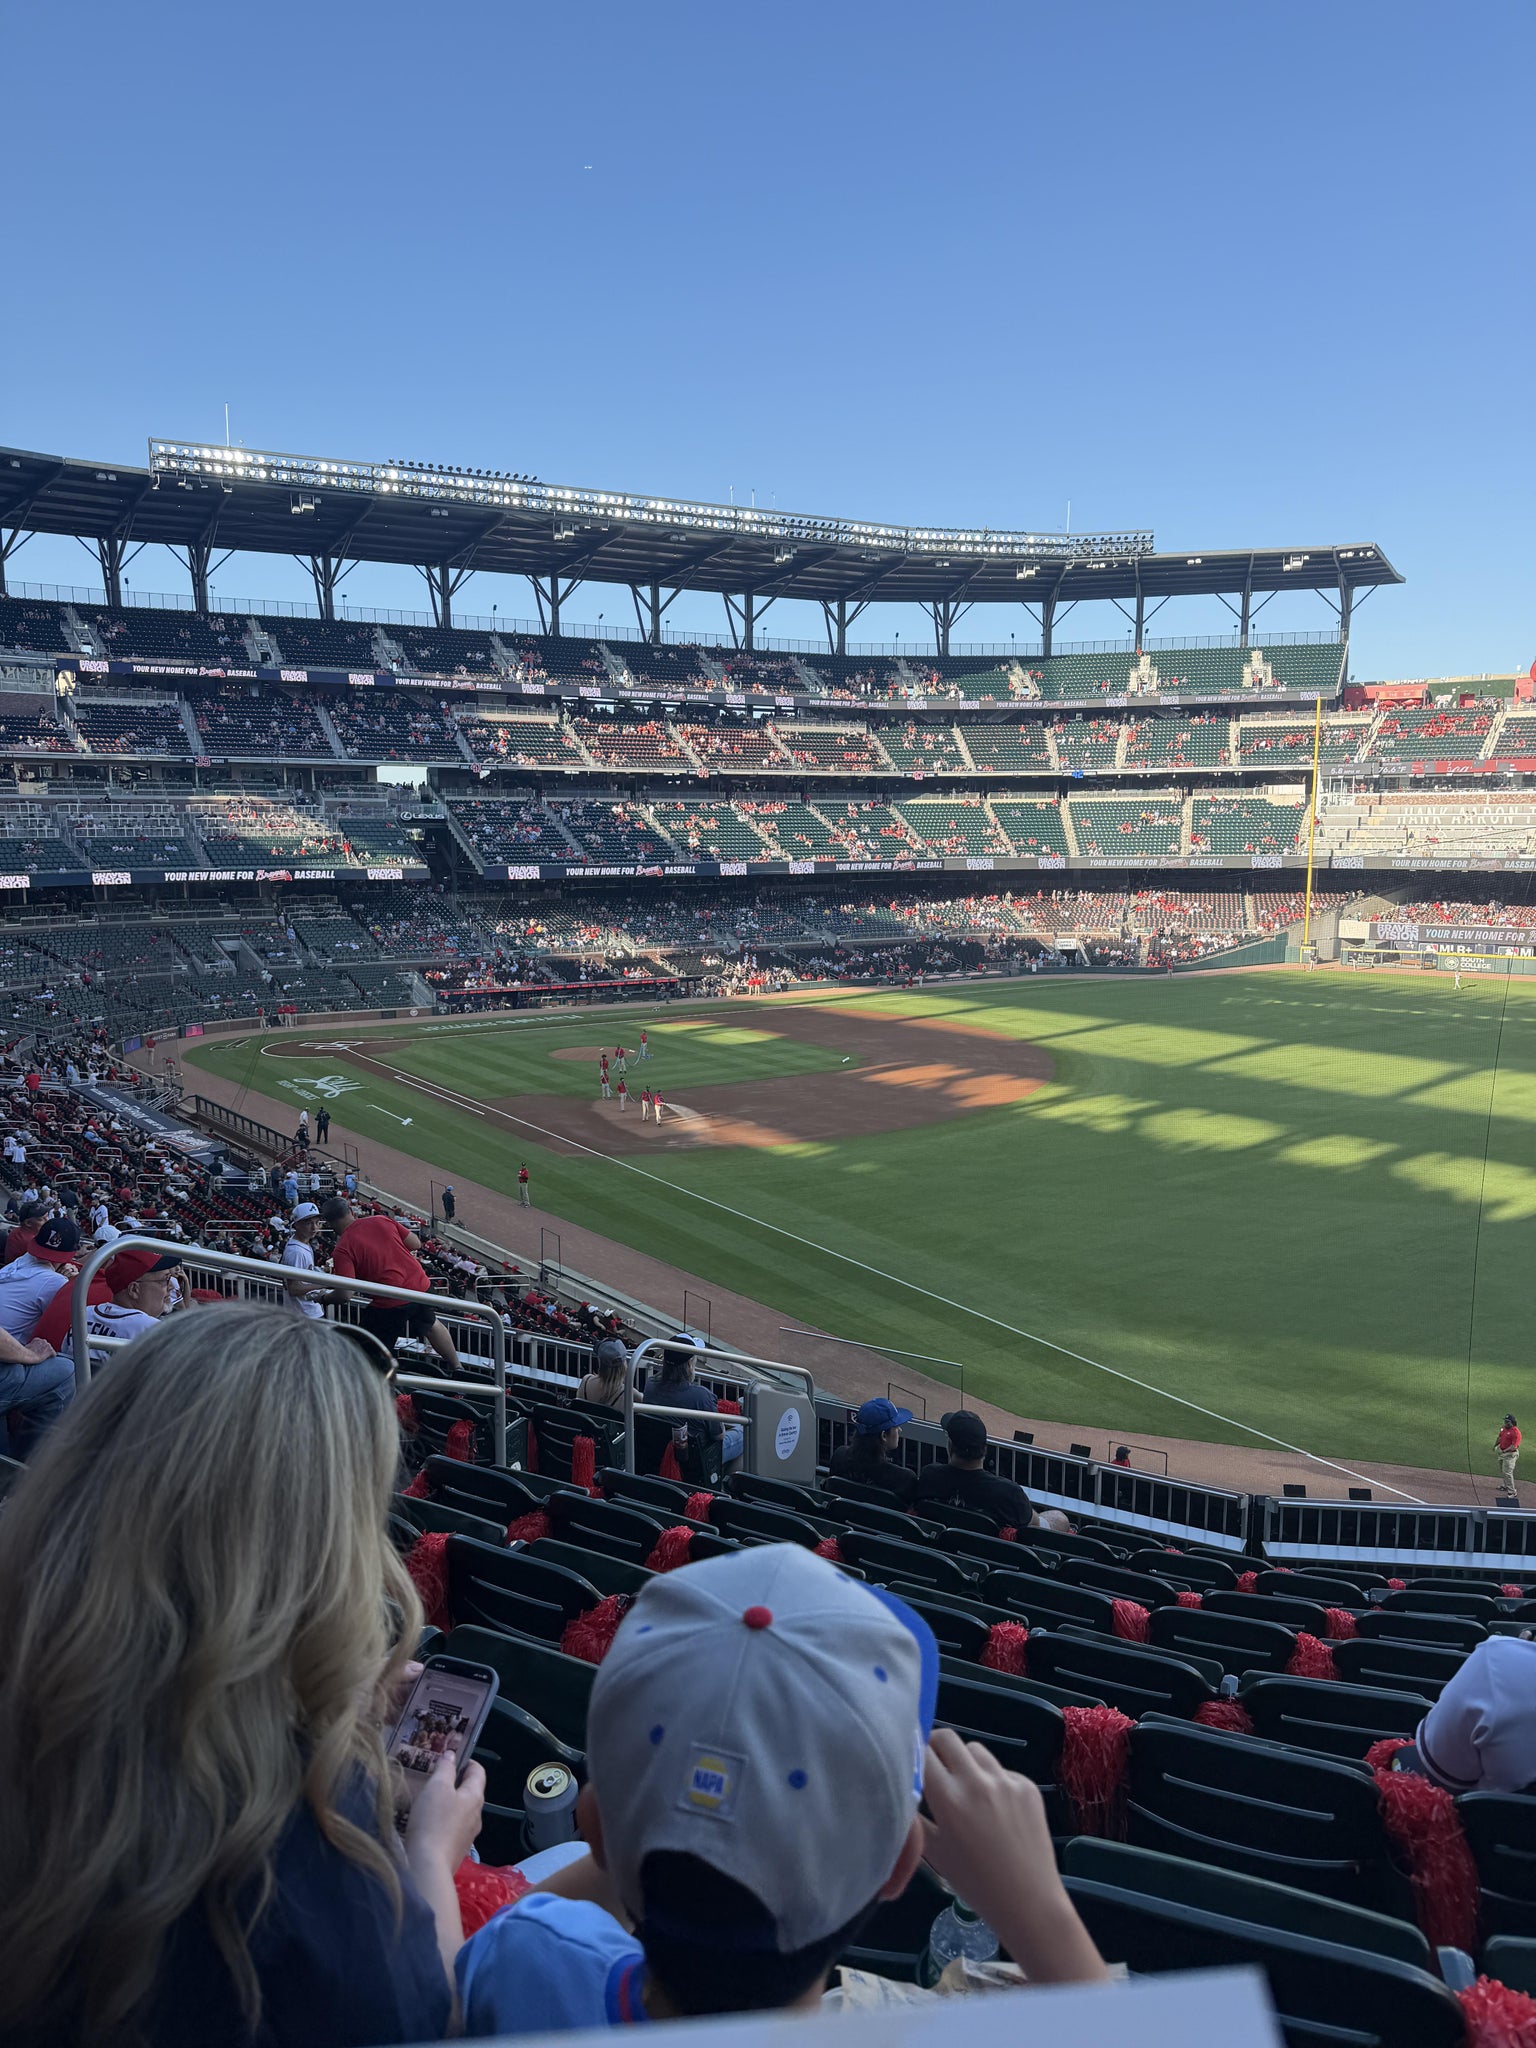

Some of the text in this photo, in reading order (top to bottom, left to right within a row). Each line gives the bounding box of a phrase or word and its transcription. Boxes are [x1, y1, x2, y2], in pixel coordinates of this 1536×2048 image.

[195, 755, 211, 767] 35
[697, 768, 709, 778] 44
[1072, 770, 1083, 779] 42
[1398, 806, 1448, 824] HANK
[1452, 806, 1518, 824] AARON
[164, 872, 188, 881] YOUR
[188, 872, 209, 881] NEW
[209, 872, 236, 880] HOME
[236, 871, 254, 880] FOR
[294, 870, 335, 879] BASEBALL
[1377, 924, 1419, 933] BRAVES
[1378, 931, 1419, 941] VISION
[1426, 928, 1450, 938] YOUR
[1451, 930, 1474, 939] NEW
[1475, 931, 1505, 940] HOME
[1505, 932, 1525, 941] FOR
